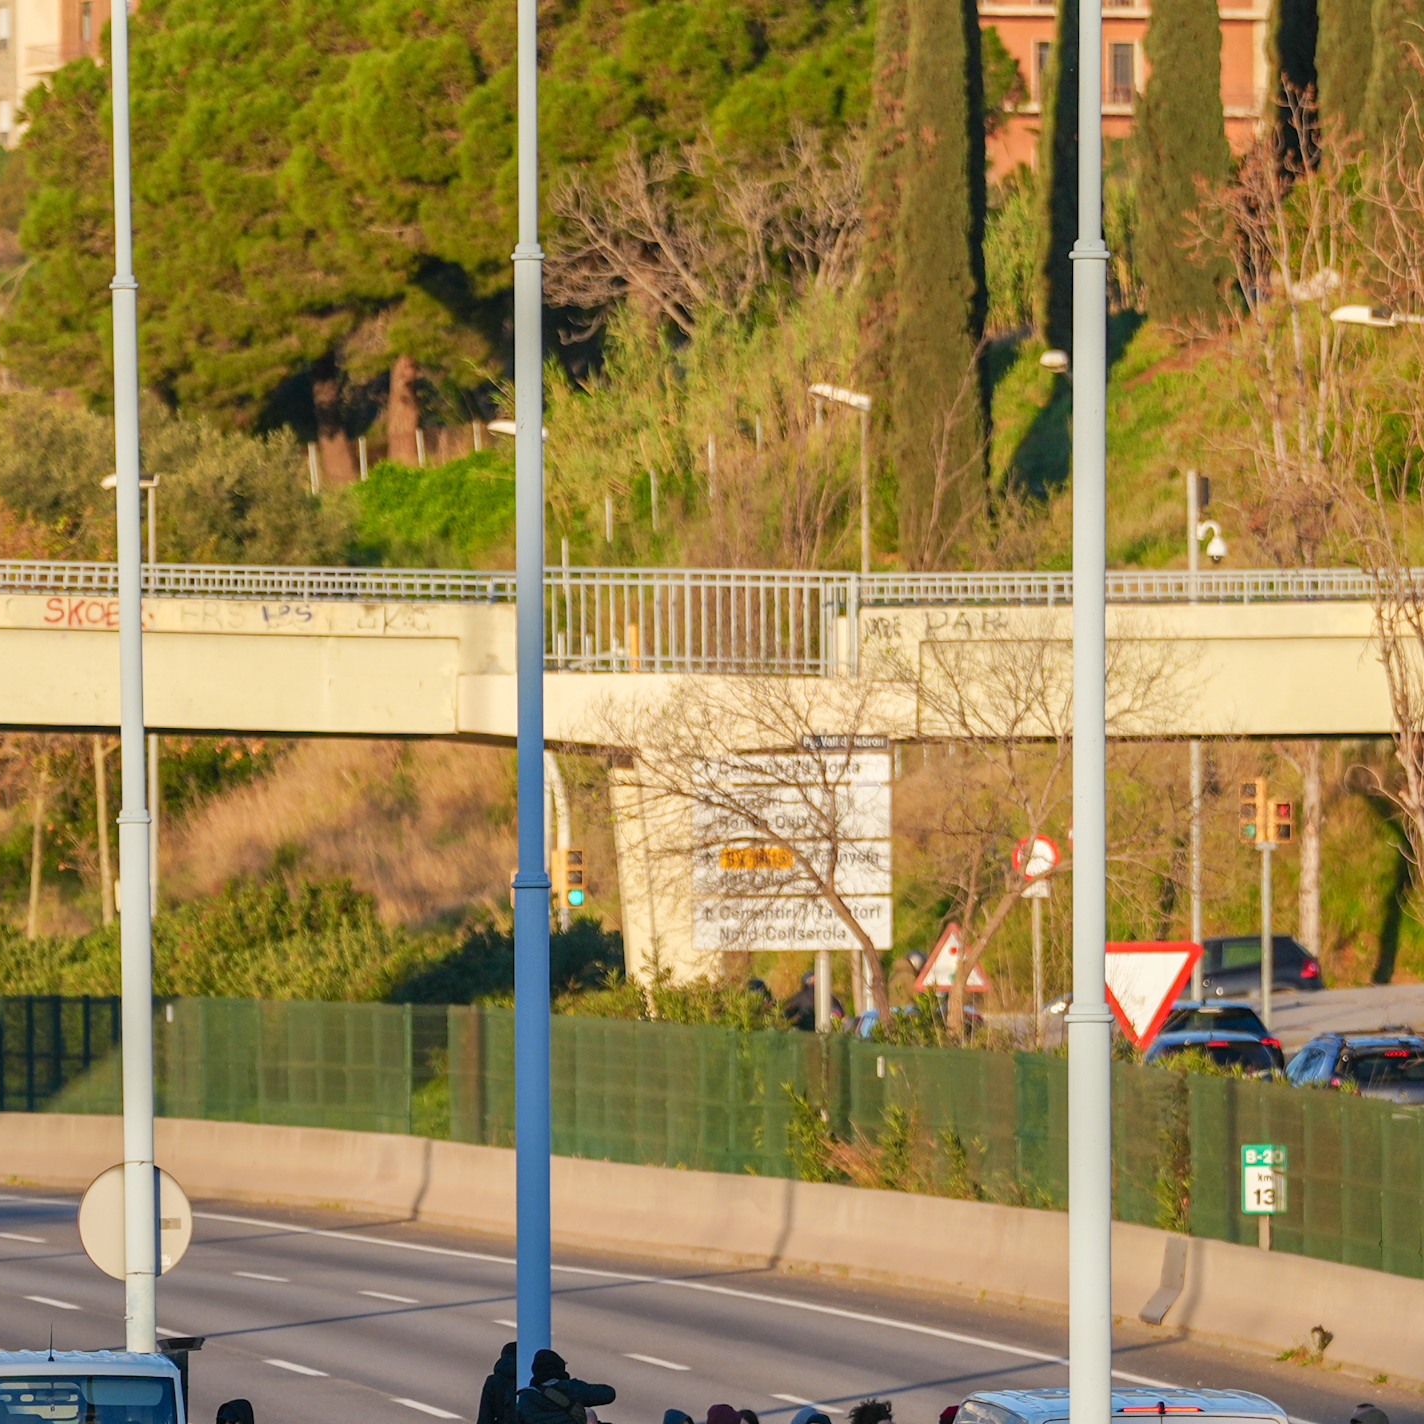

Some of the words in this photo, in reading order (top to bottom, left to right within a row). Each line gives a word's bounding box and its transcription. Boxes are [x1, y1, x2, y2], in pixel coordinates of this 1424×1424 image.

[821, 736, 839, 747] Vall
[840, 736, 885, 747] debron
[816, 904, 881, 920] Tatori
[1245, 1149, 1284, 1164] B-20
[1257, 1172, 1273, 1183] km
[1253, 1188, 1276, 1206] 13
